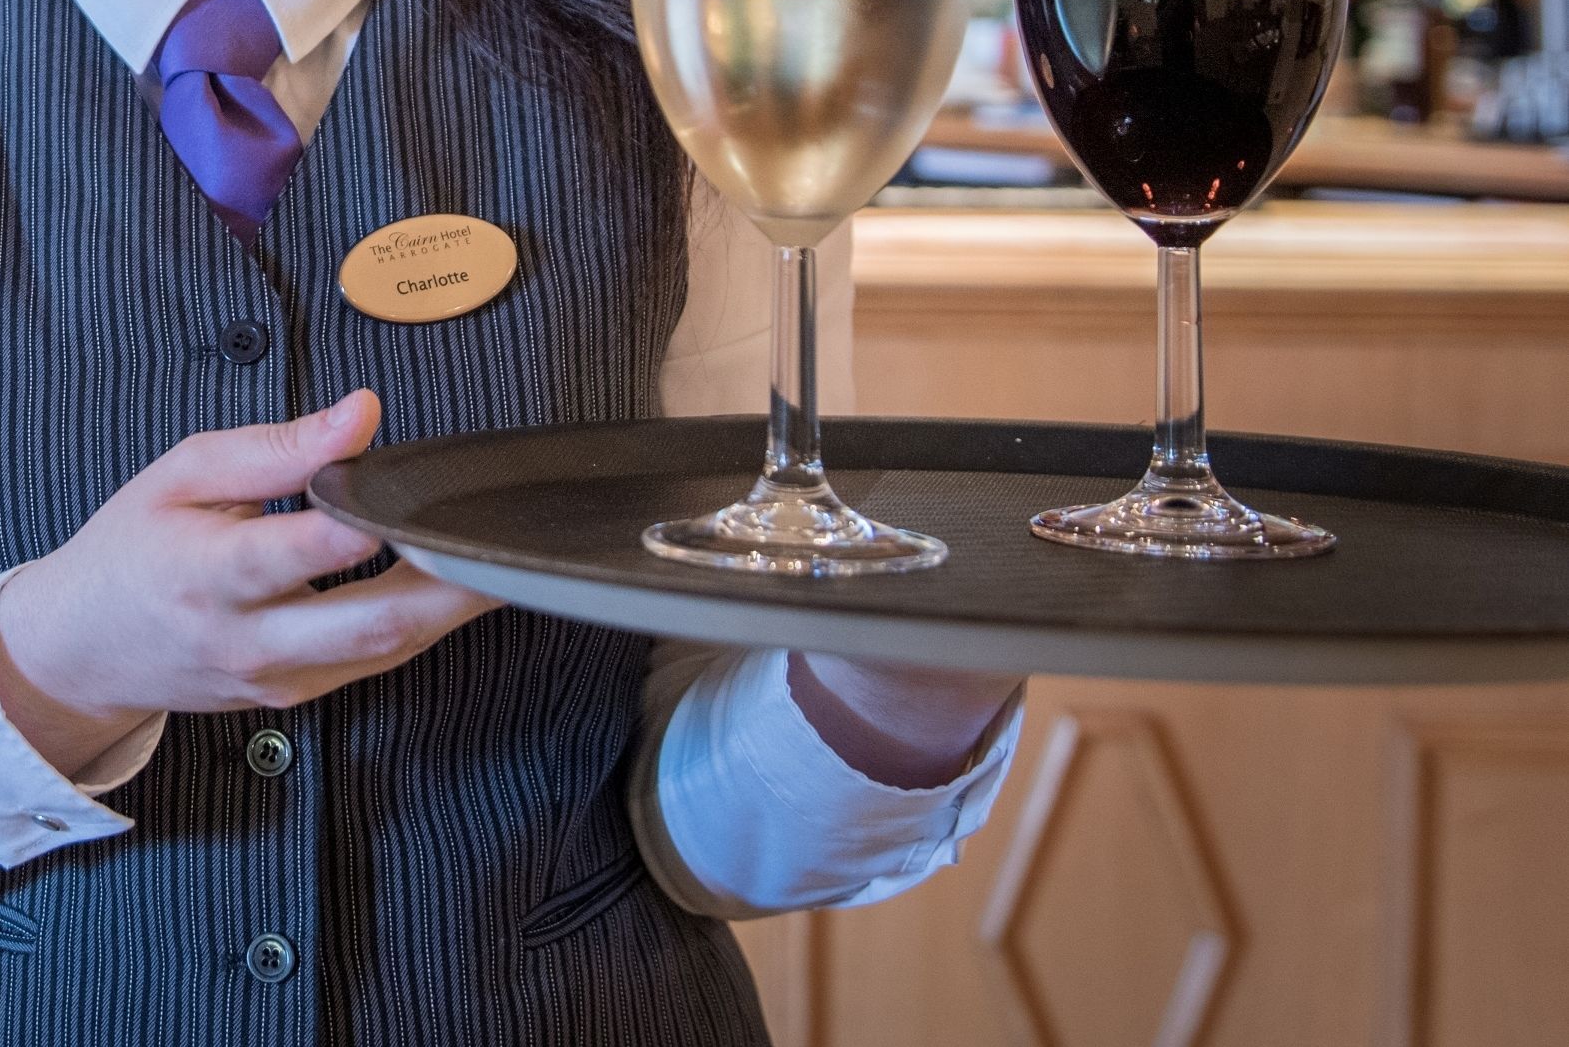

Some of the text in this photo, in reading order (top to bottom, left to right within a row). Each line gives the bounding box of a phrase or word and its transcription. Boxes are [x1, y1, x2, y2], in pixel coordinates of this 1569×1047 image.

[369, 225, 472, 256] The Cairn Hotel
[377, 237, 472, 264] HARROGATE
[396, 271, 470, 295] Charlotte
